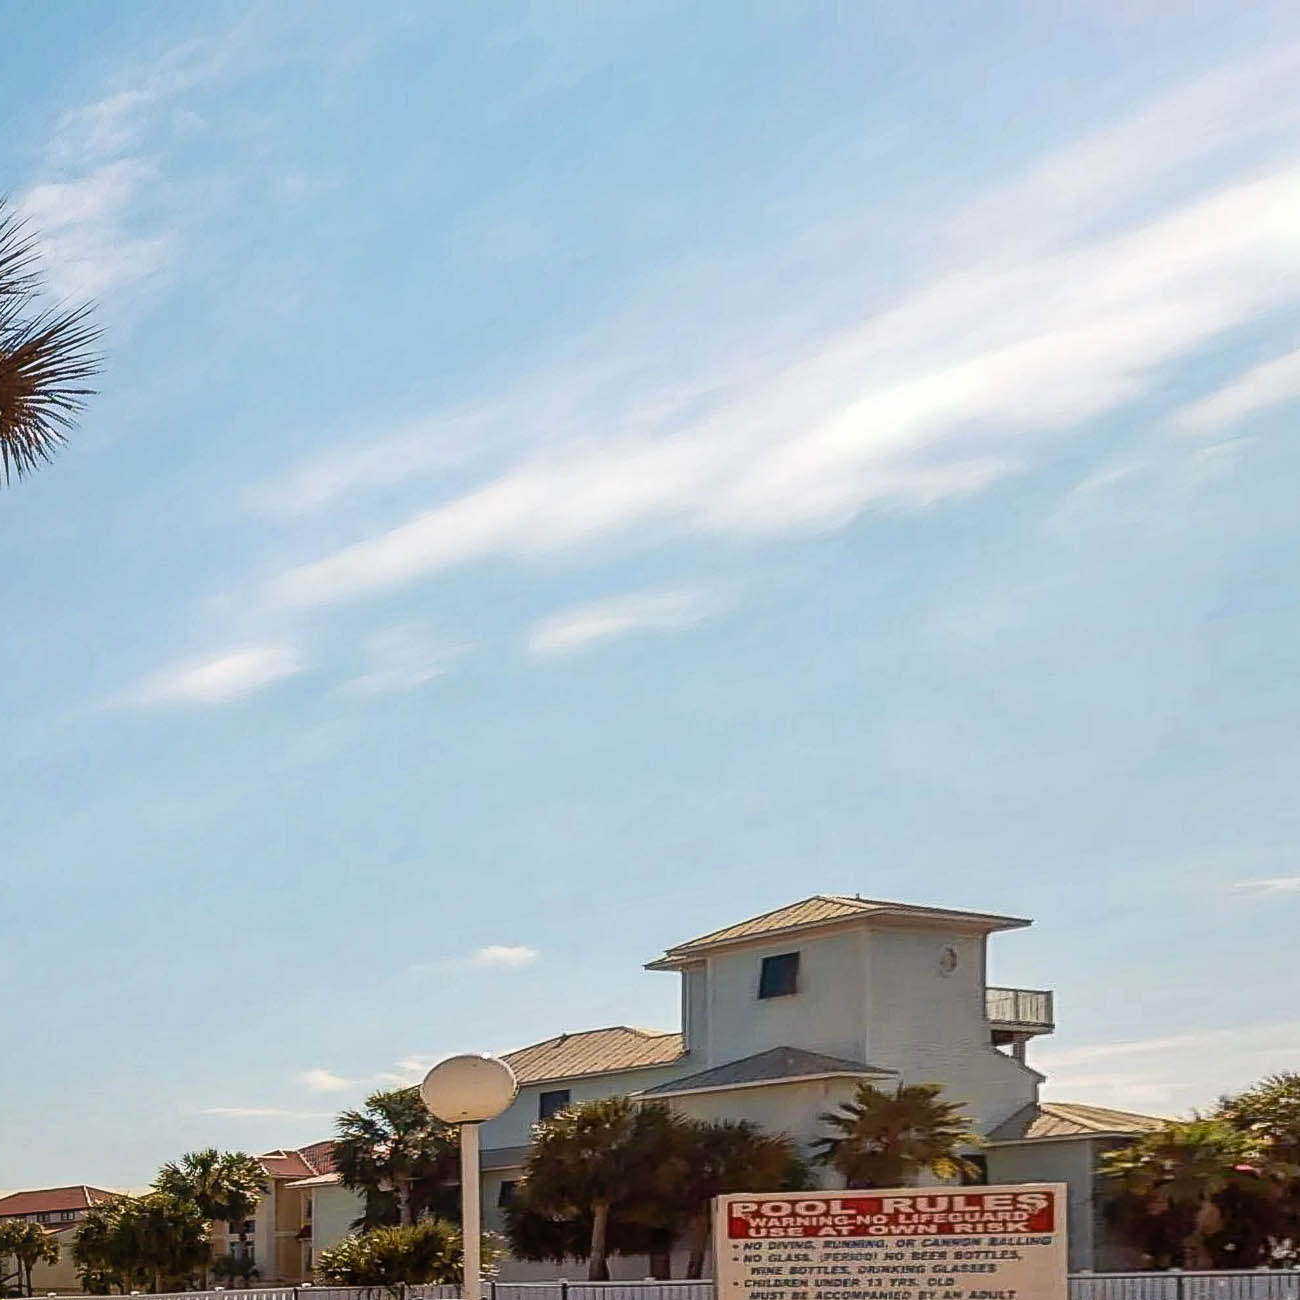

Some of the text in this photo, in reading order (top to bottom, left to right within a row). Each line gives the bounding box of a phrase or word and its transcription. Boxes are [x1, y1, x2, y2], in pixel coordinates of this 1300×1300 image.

[732, 1195, 1048, 1218] POOL RULES
[899, 1211, 1030, 1224] LIFEGUARD
[749, 1222, 1030, 1237] USE AT OWN RISK
[743, 1241, 762, 1250] NO
[743, 1254, 762, 1263] NO
[932, 1263, 998, 1273] GLASSES
[744, 1279, 809, 1288] CHILDREN
[815, 1278, 860, 1287] UNDER
[928, 1278, 955, 1286] OLD
[749, 1290, 1017, 1300] MUST BE ACCOMPANIED BY AN ADULT
